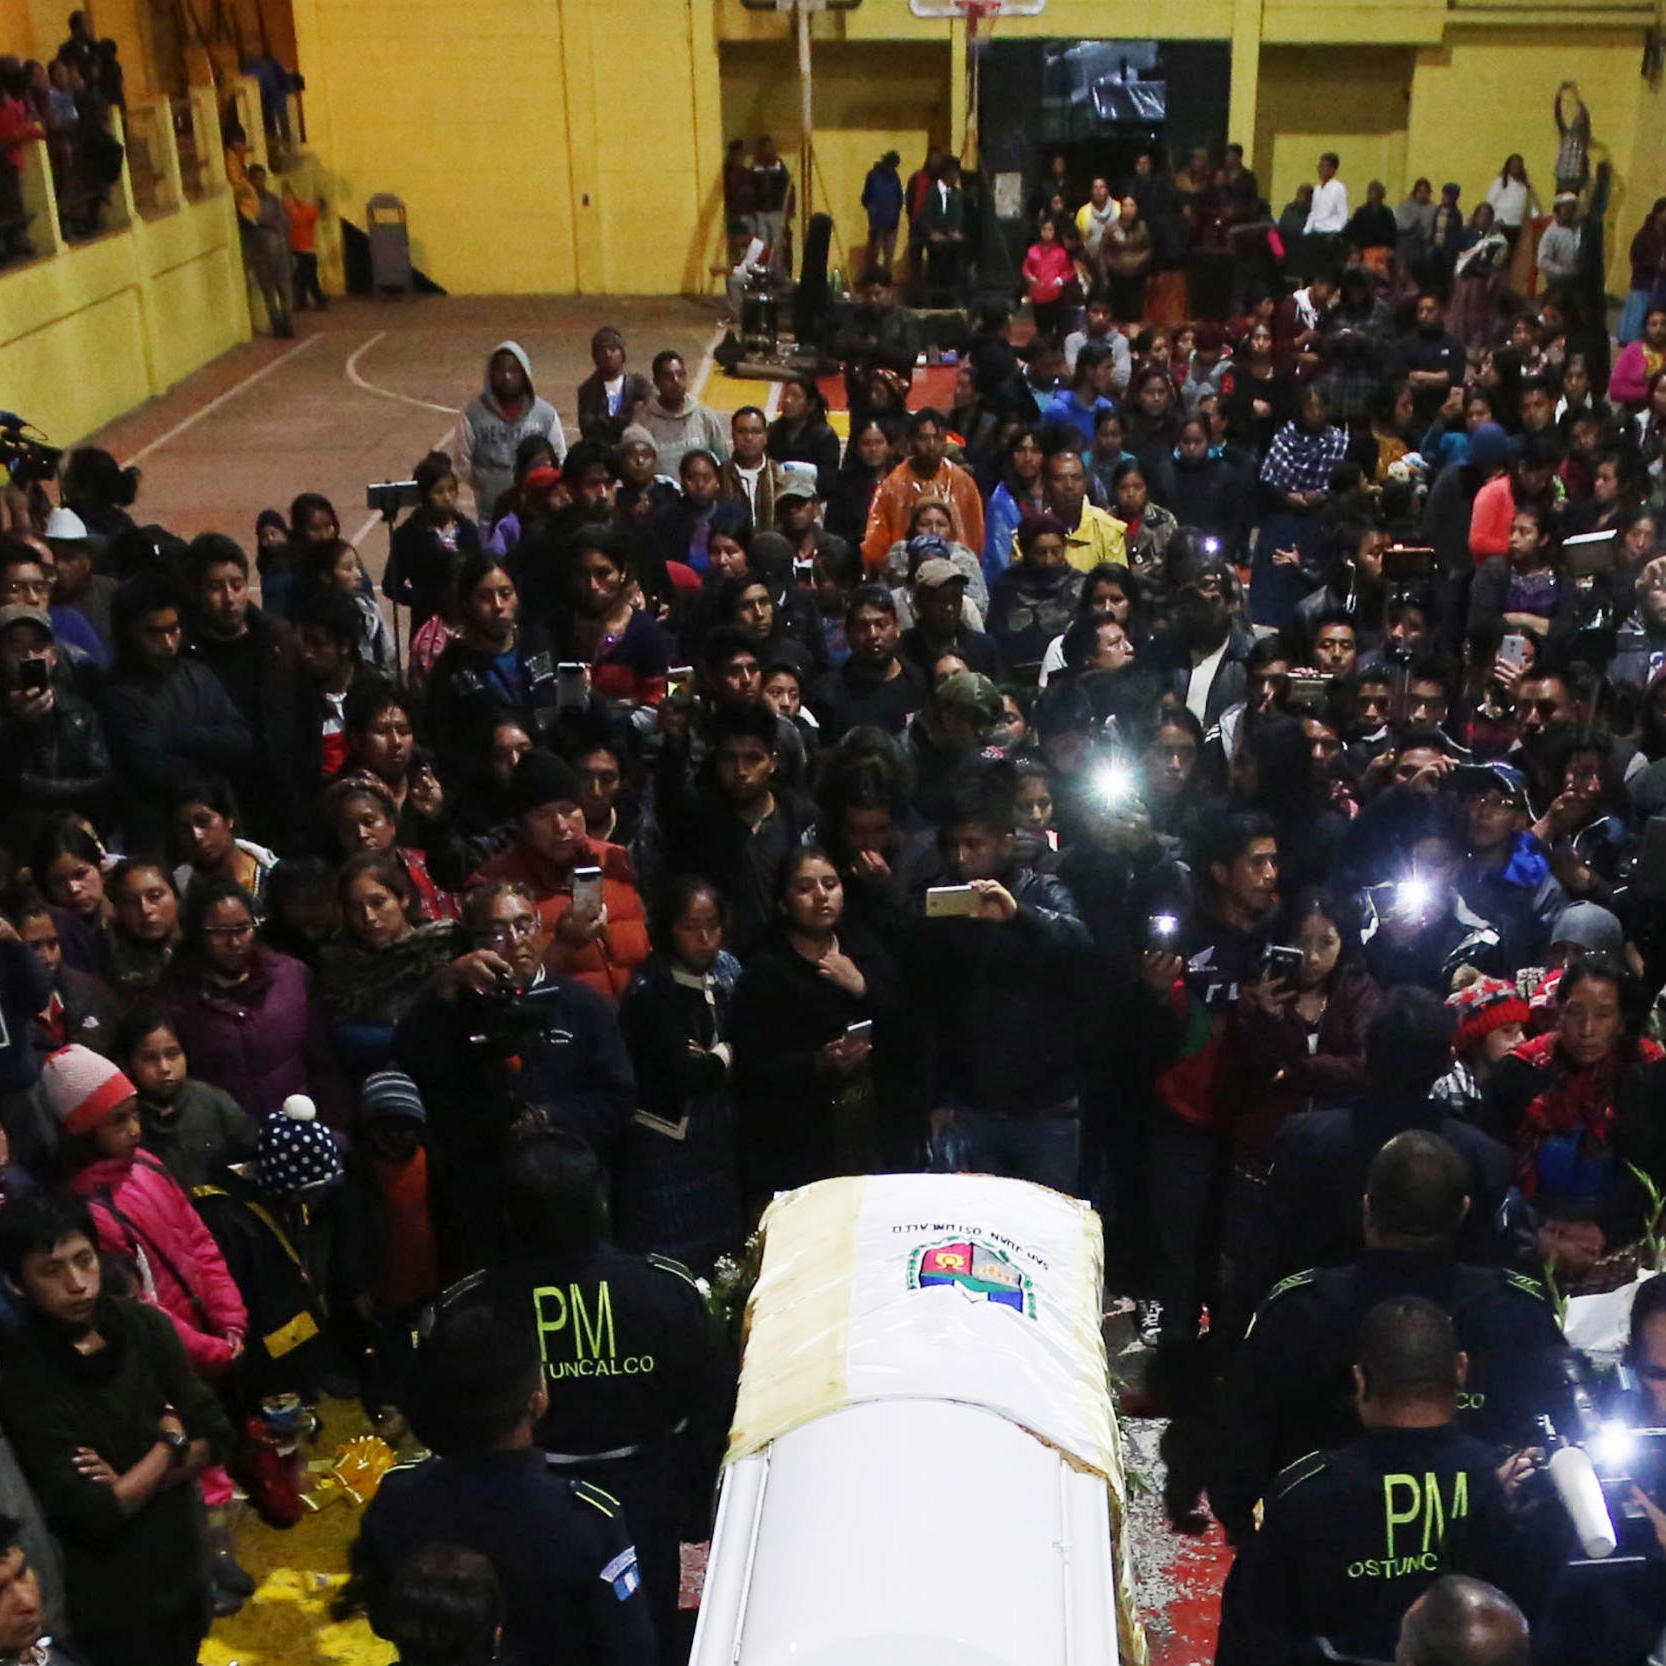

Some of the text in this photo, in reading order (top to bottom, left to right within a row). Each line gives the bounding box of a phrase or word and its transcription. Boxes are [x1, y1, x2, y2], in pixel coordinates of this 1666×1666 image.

[533, 1280, 616, 1362] PM
[1383, 1471, 1469, 1558] PM
[1347, 1552, 1438, 1579] OSTUNC
